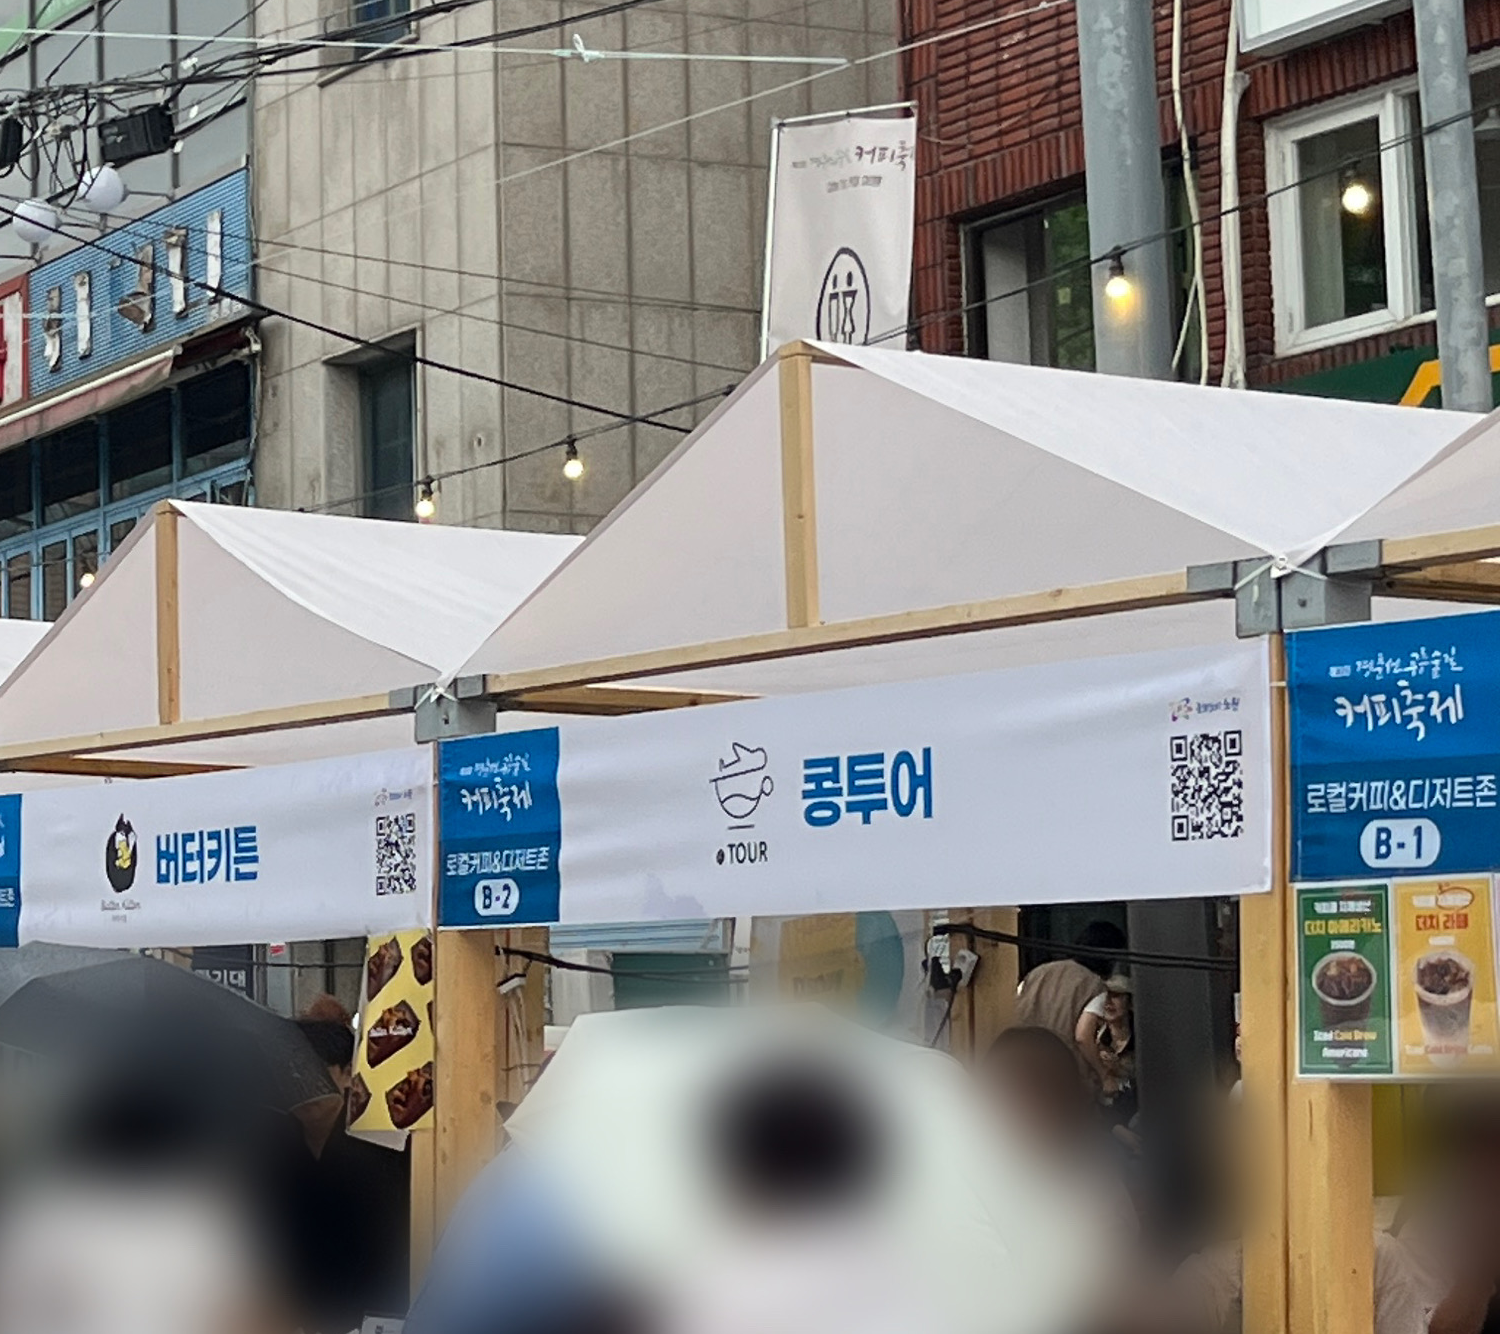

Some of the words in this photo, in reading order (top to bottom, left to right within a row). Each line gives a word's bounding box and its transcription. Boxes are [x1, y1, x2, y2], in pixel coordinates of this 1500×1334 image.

[1334, 679, 1464, 741] 커피축제
[801, 747, 934, 827] 콩투어
[1307, 774, 1498, 813] 로컬커피&디저트존
[156, 826, 260, 886] 버터키튼
[728, 841, 769, 864] TOUR
